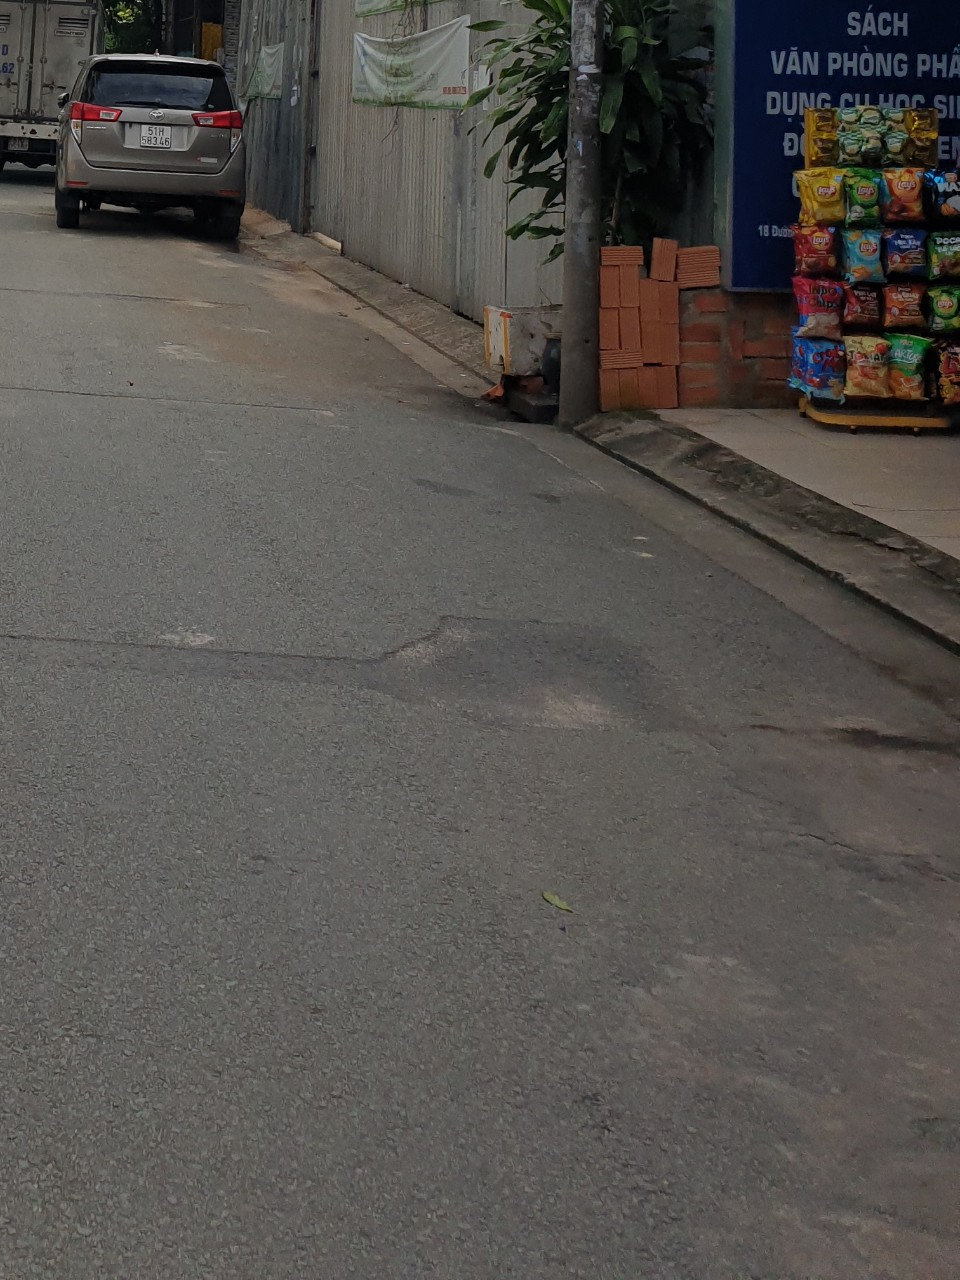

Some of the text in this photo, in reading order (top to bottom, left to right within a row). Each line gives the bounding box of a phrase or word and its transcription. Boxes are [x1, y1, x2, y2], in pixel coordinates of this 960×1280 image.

[846, 3, 909, 37] SÁCH
[770, 46, 819, 76] VĂN
[827, 45, 908, 78] PHÒNG
[933, 94, 960, 120] SI
[141, 137, 170, 147] 583.46
[147, 126, 165, 136] 51H
[783, 128, 804, 157] Đ
[758, 224, 769, 237] 18
